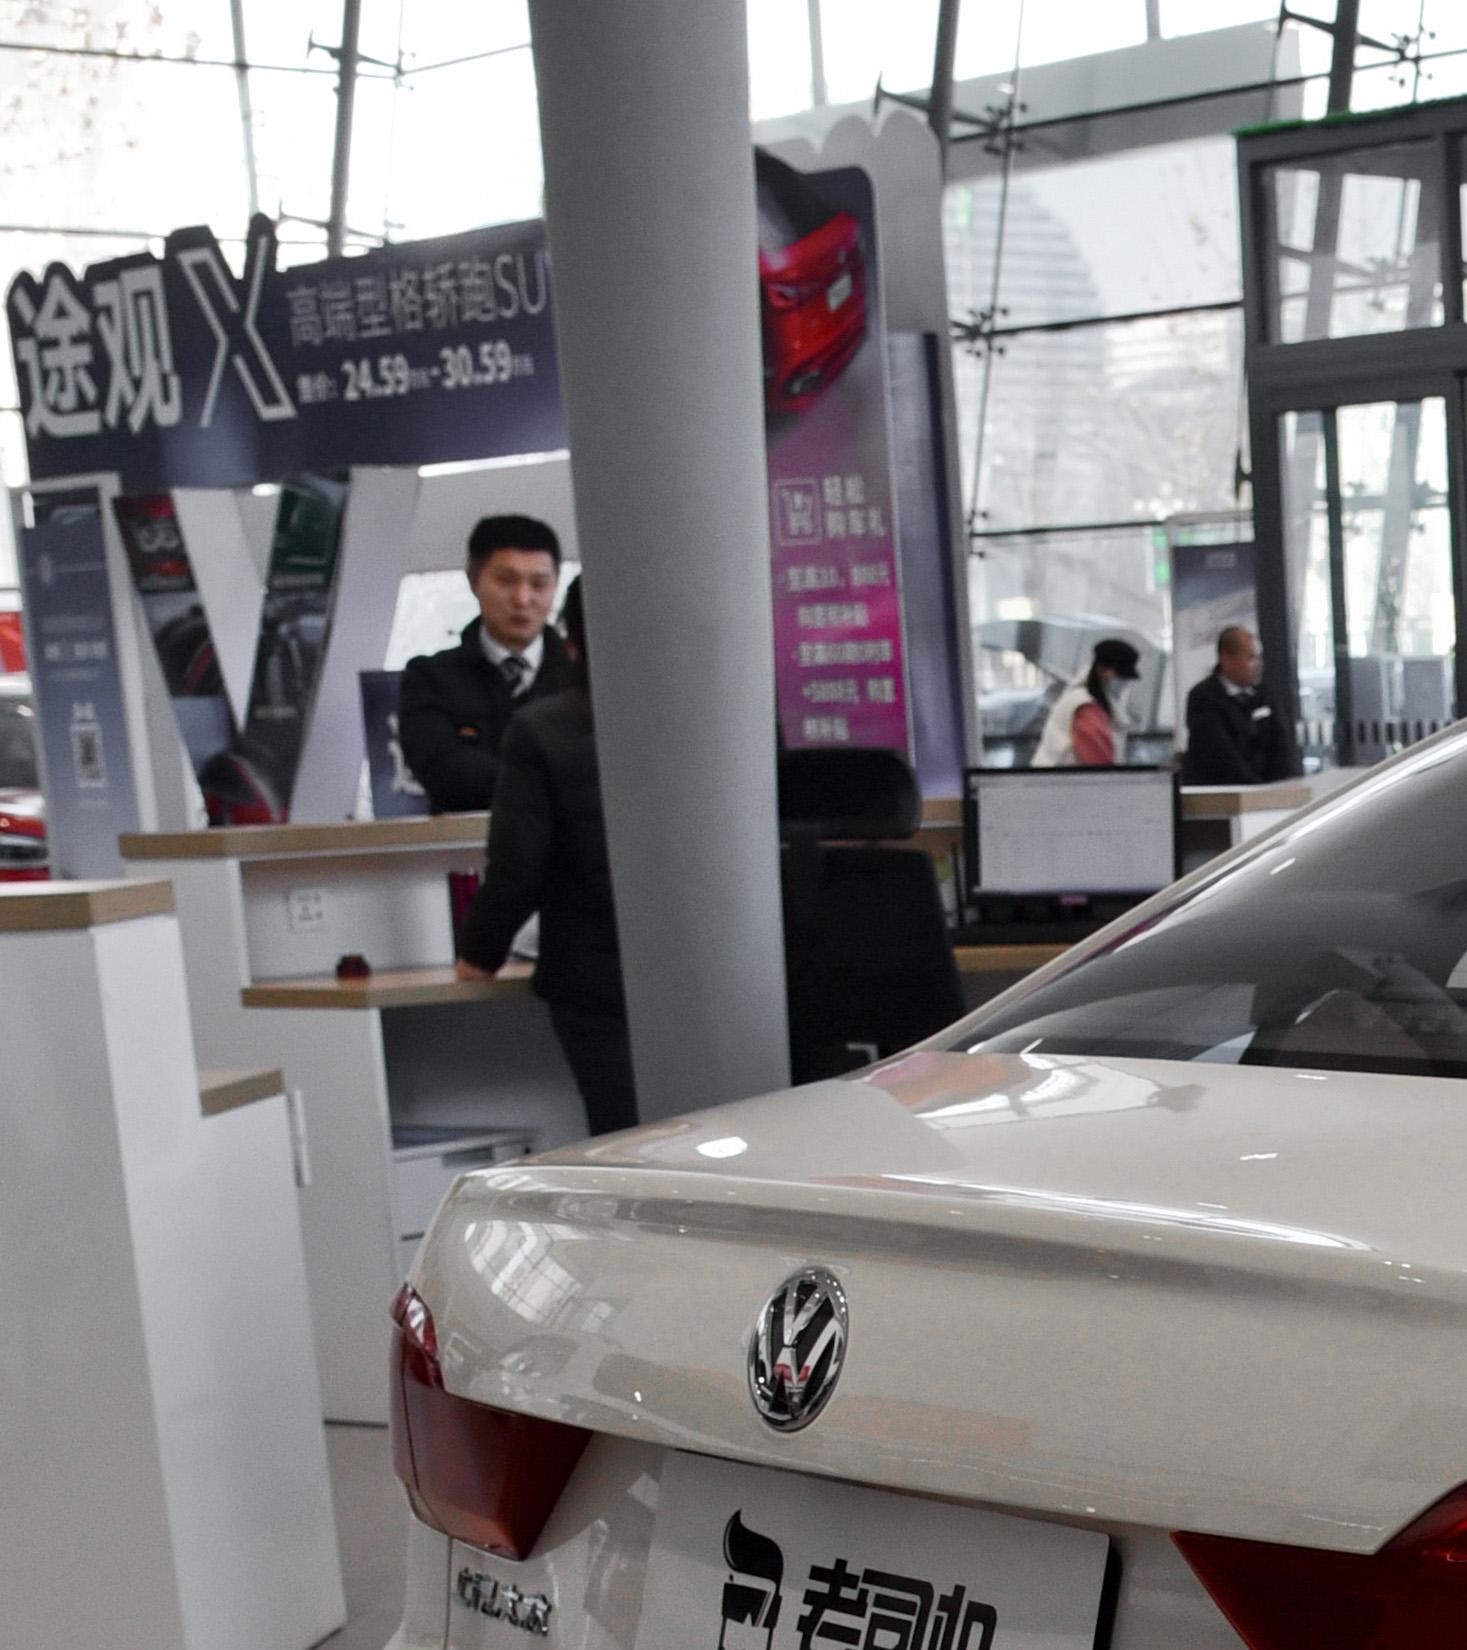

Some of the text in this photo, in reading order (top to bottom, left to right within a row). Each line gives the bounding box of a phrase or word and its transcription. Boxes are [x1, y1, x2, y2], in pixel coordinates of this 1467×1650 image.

[13, 235, 297, 440] 途观X
[285, 250, 551, 348] 高端型格轿跑SU
